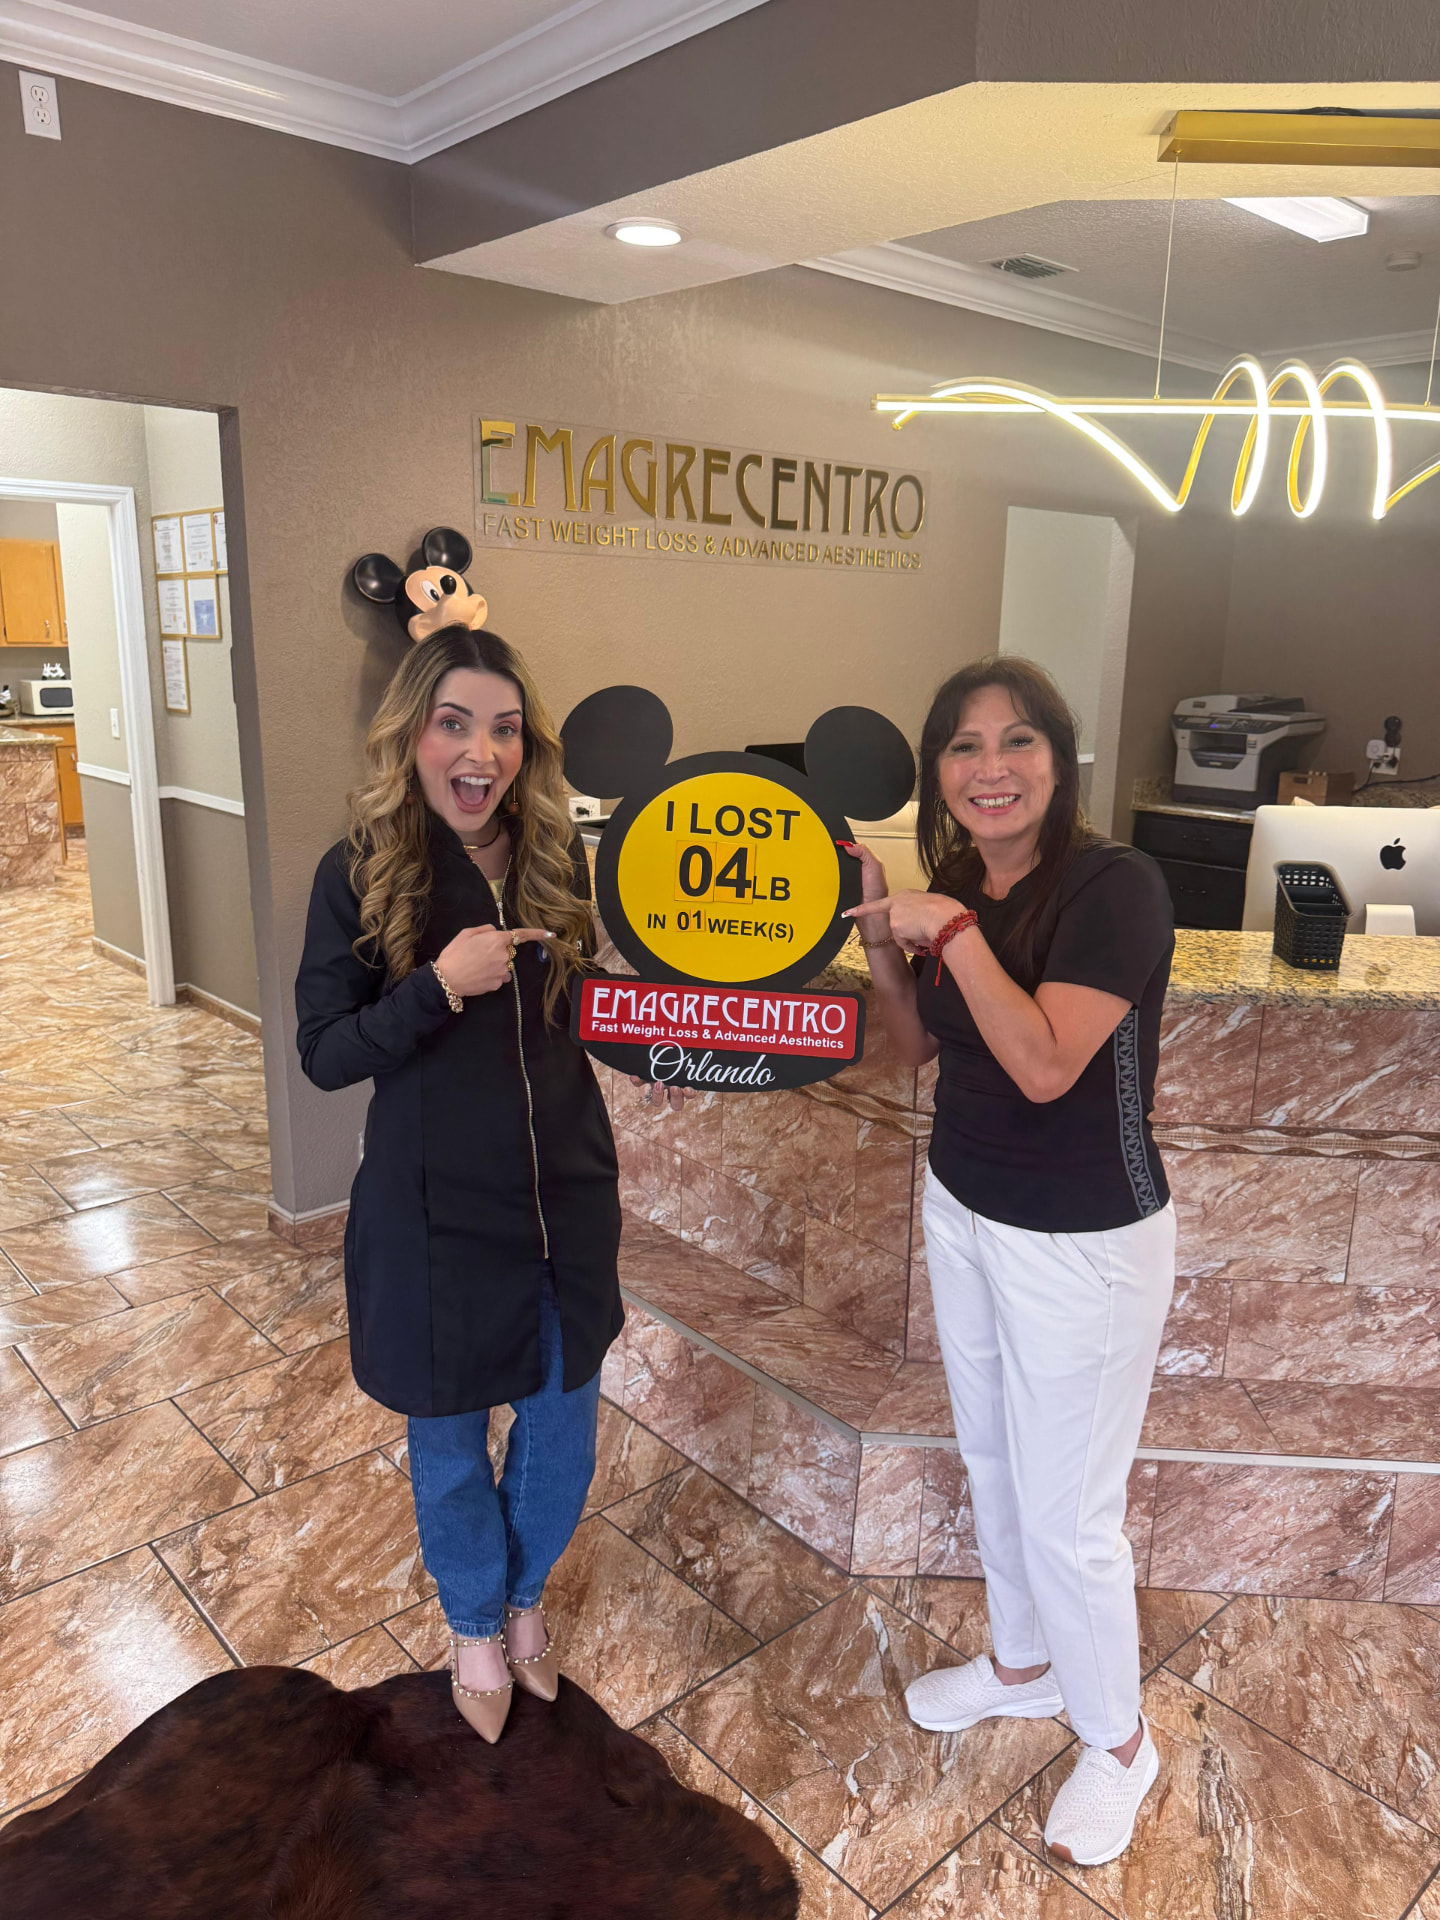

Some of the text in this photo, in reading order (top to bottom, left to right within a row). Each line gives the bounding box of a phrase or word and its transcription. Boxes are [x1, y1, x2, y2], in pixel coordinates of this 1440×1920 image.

[480, 418, 925, 539] EMAGRECENTRO
[484, 512, 922, 569] FAST WEIGHT LOSS & ADVANCED AESTHETICS
[665, 801, 800, 841] I LOST
[679, 845, 791, 901] 04 LB
[647, 910, 794, 943] IN 01 WEEK(S)
[592, 987, 846, 1034] EMAGRECENTRO
[591, 1021, 844, 1049] Fast Weight Loss & Advanced Aesthetics
[649, 1040, 775, 1086] Orlando
